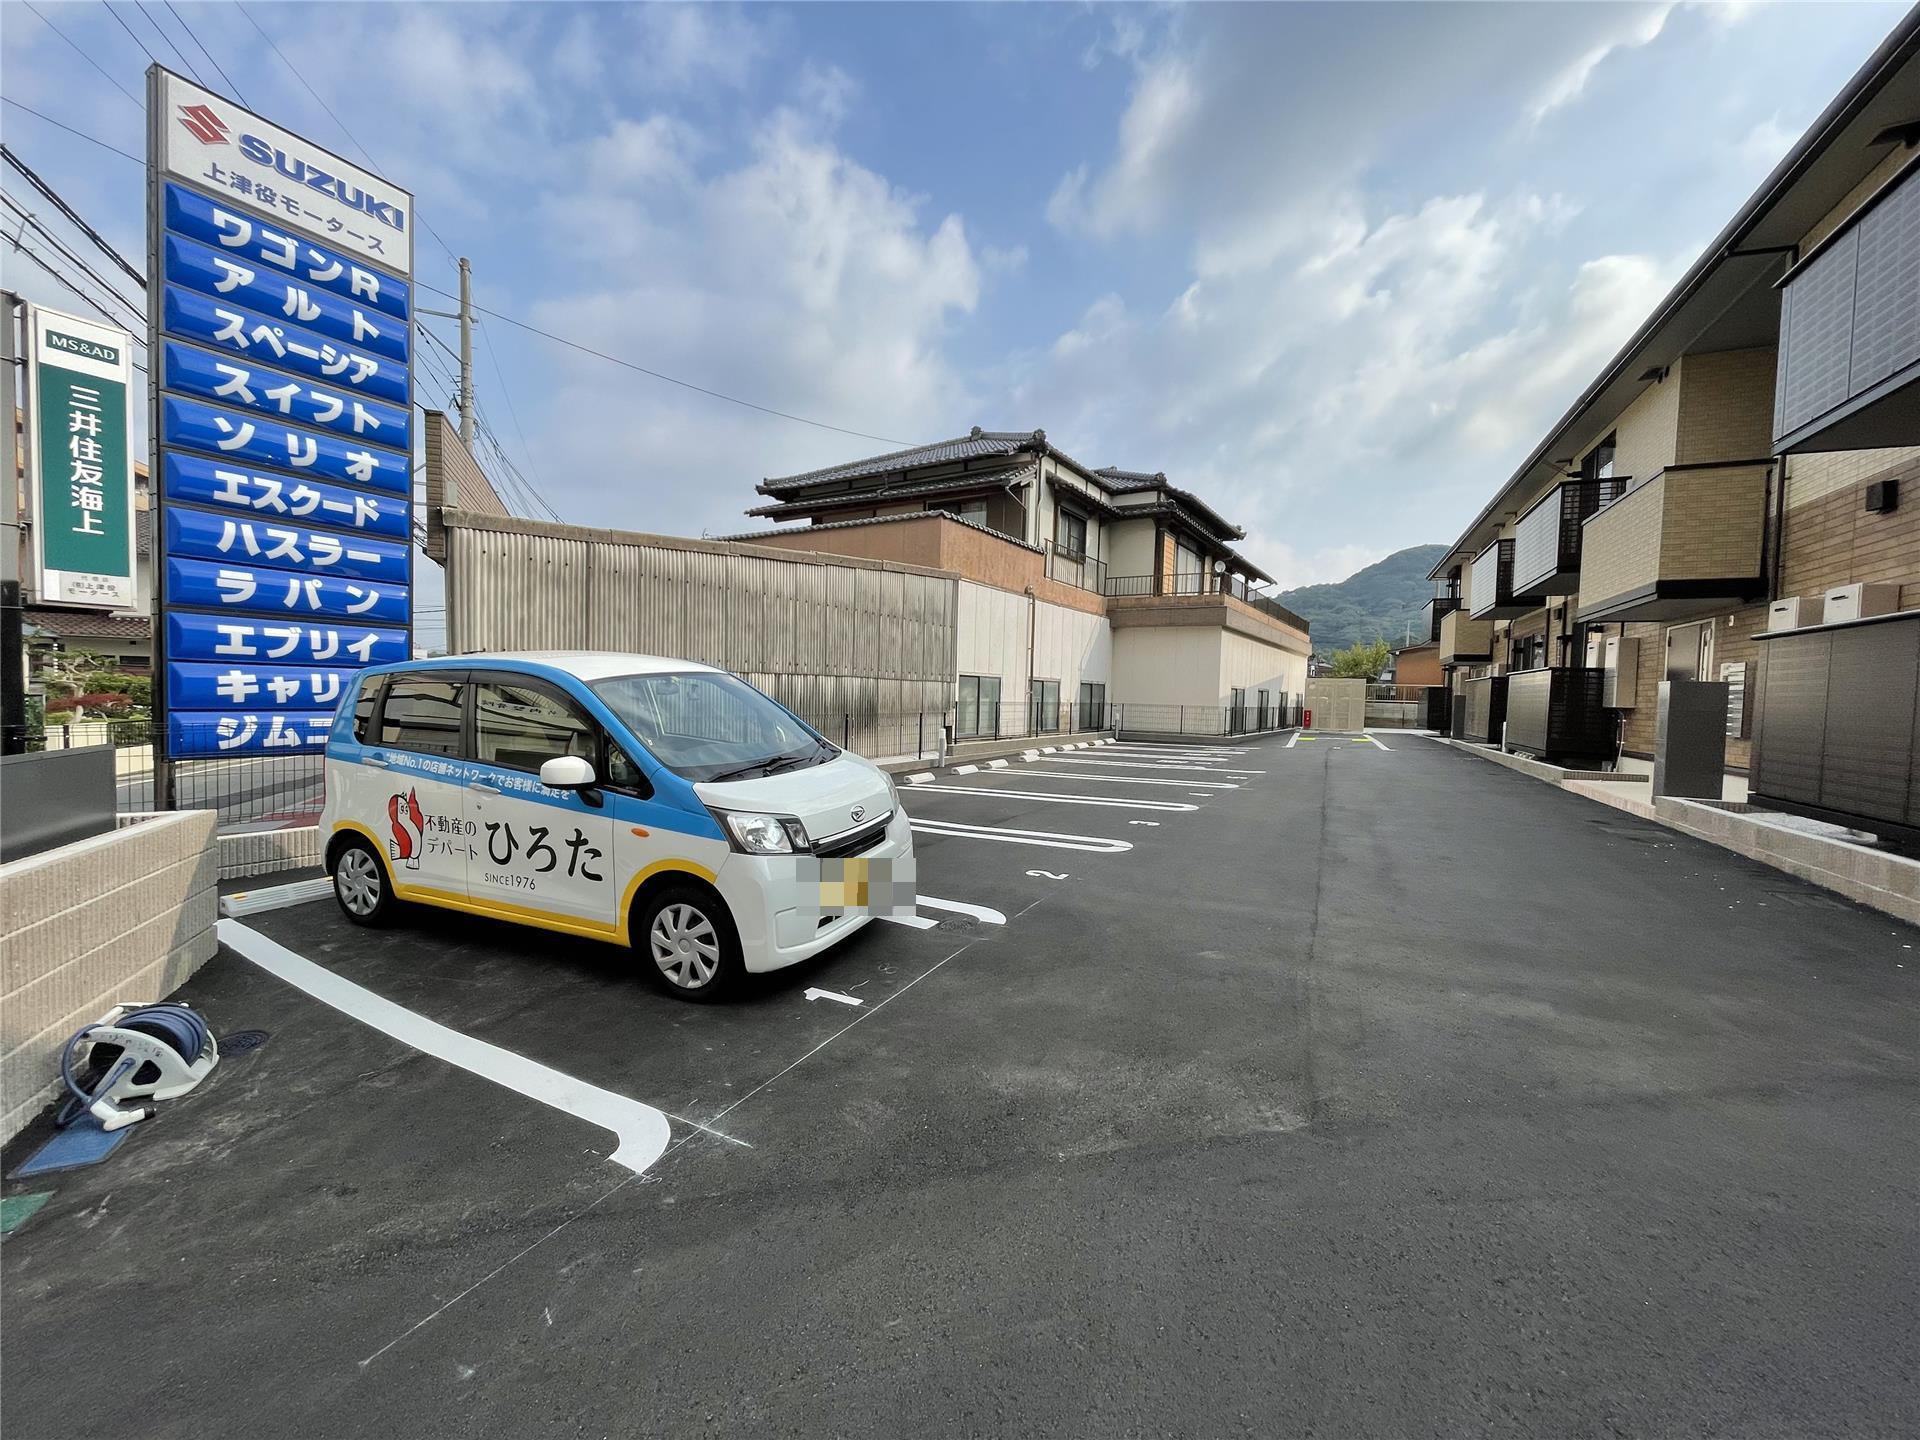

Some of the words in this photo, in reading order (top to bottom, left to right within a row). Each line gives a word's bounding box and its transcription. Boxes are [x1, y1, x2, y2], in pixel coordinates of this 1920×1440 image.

[203, 161, 385, 255] 上津役モータース
[238, 132, 404, 232] SUZUKI
[213, 207, 381, 303] ワゴンR
[213, 257, 381, 341] アルト
[51, 334, 116, 361] MS&AD
[213, 308, 378, 384] スペーシア
[213, 363, 381, 433] スイフト
[69, 385, 104, 535] 三井住友海上
[213, 417, 380, 481] ソリオ
[213, 470, 380, 527] エスクード
[216, 520, 381, 565] ハスラー
[216, 569, 380, 614] ラパン
[215, 624, 380, 662] エブリイ
[424, 814, 477, 837] 不動産の
[426, 838, 478, 861] デパート
[484, 821, 604, 882] ひろた
[1025, 869, 1069, 880] 2
[803, 987, 864, 1006] 1
